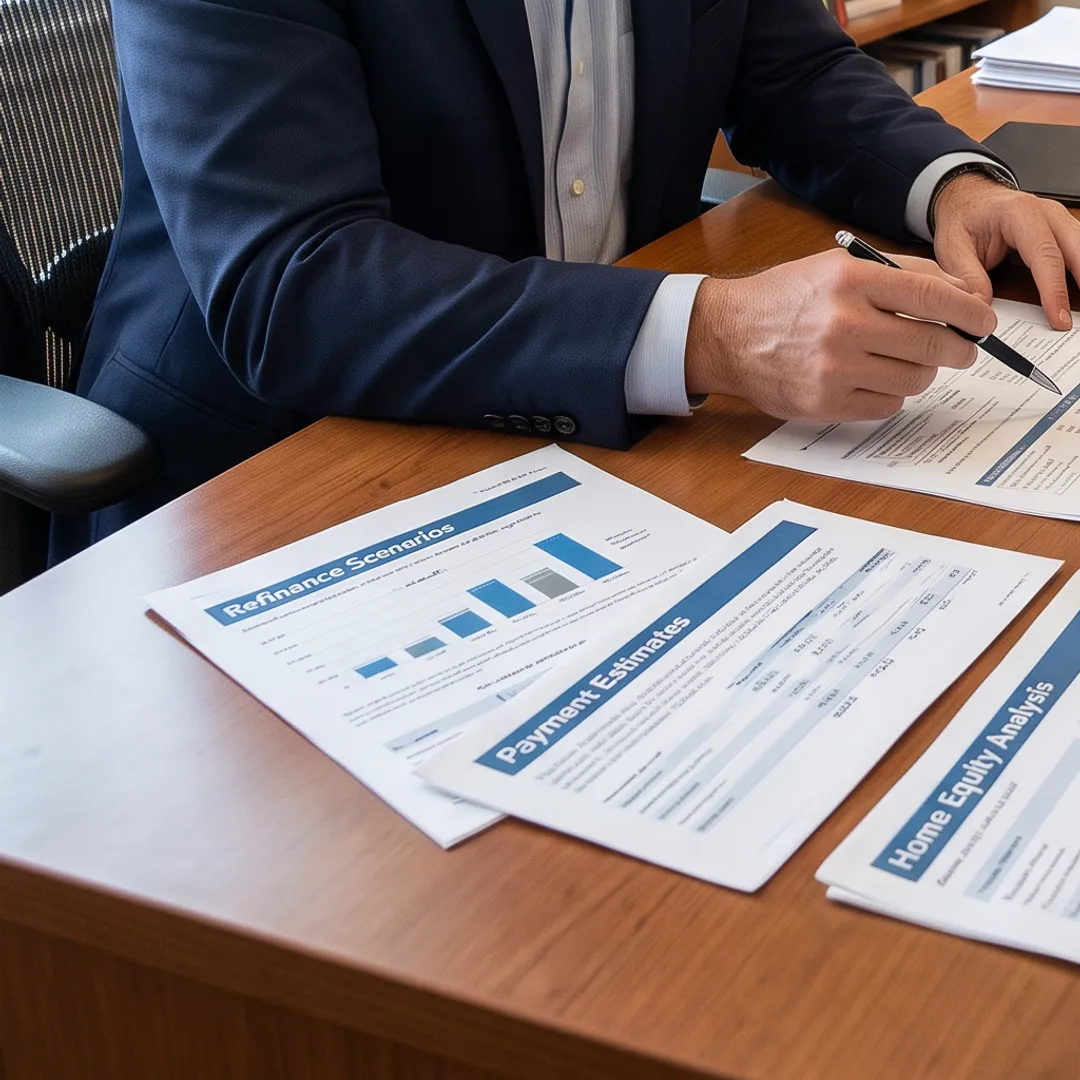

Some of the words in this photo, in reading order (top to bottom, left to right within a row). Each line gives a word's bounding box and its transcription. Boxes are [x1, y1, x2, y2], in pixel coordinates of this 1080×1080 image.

[223, 567, 345, 618] Refinance
[345, 523, 455, 570] Scenarios
[496, 688, 601, 764] Payment
[589, 617, 690, 690] Estimates
[888, 809, 952, 870] Home
[986, 682, 1054, 749] Analysis
